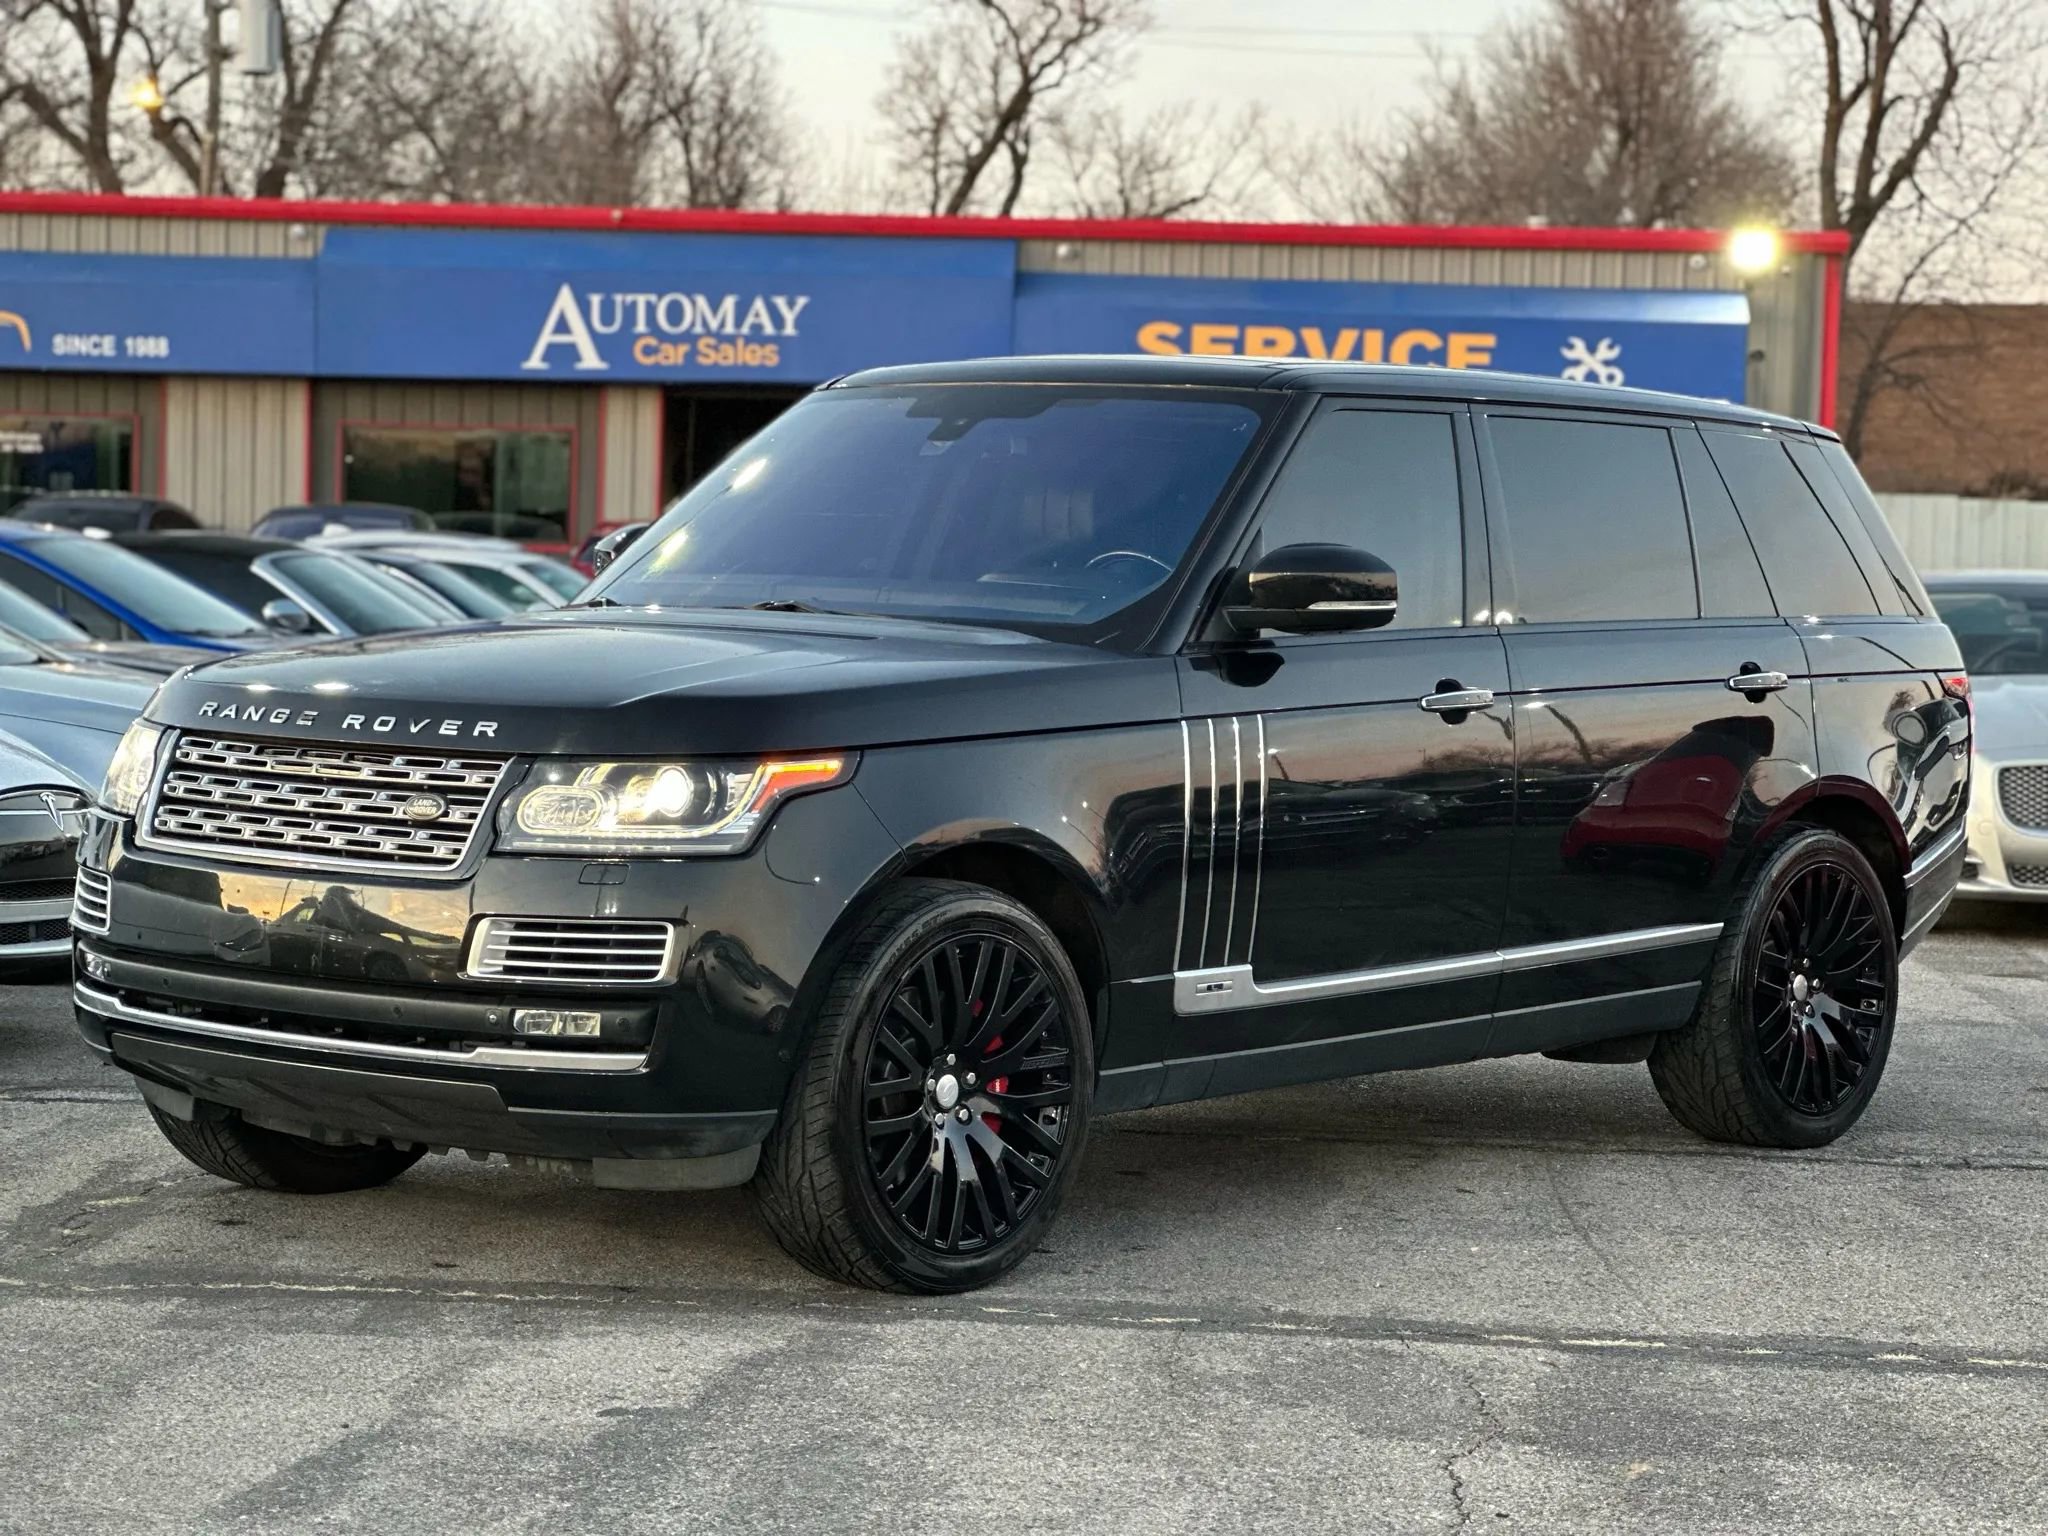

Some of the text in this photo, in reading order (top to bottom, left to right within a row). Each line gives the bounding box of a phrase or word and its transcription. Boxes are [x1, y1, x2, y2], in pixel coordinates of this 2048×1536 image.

[520, 282, 810, 370] AUTOMAY
[52, 333, 117, 357] SINCE
[633, 335, 780, 367] Car Sales
[1134, 321, 1497, 369] SERVICE
[198, 701, 499, 738] RANGE ROVER
